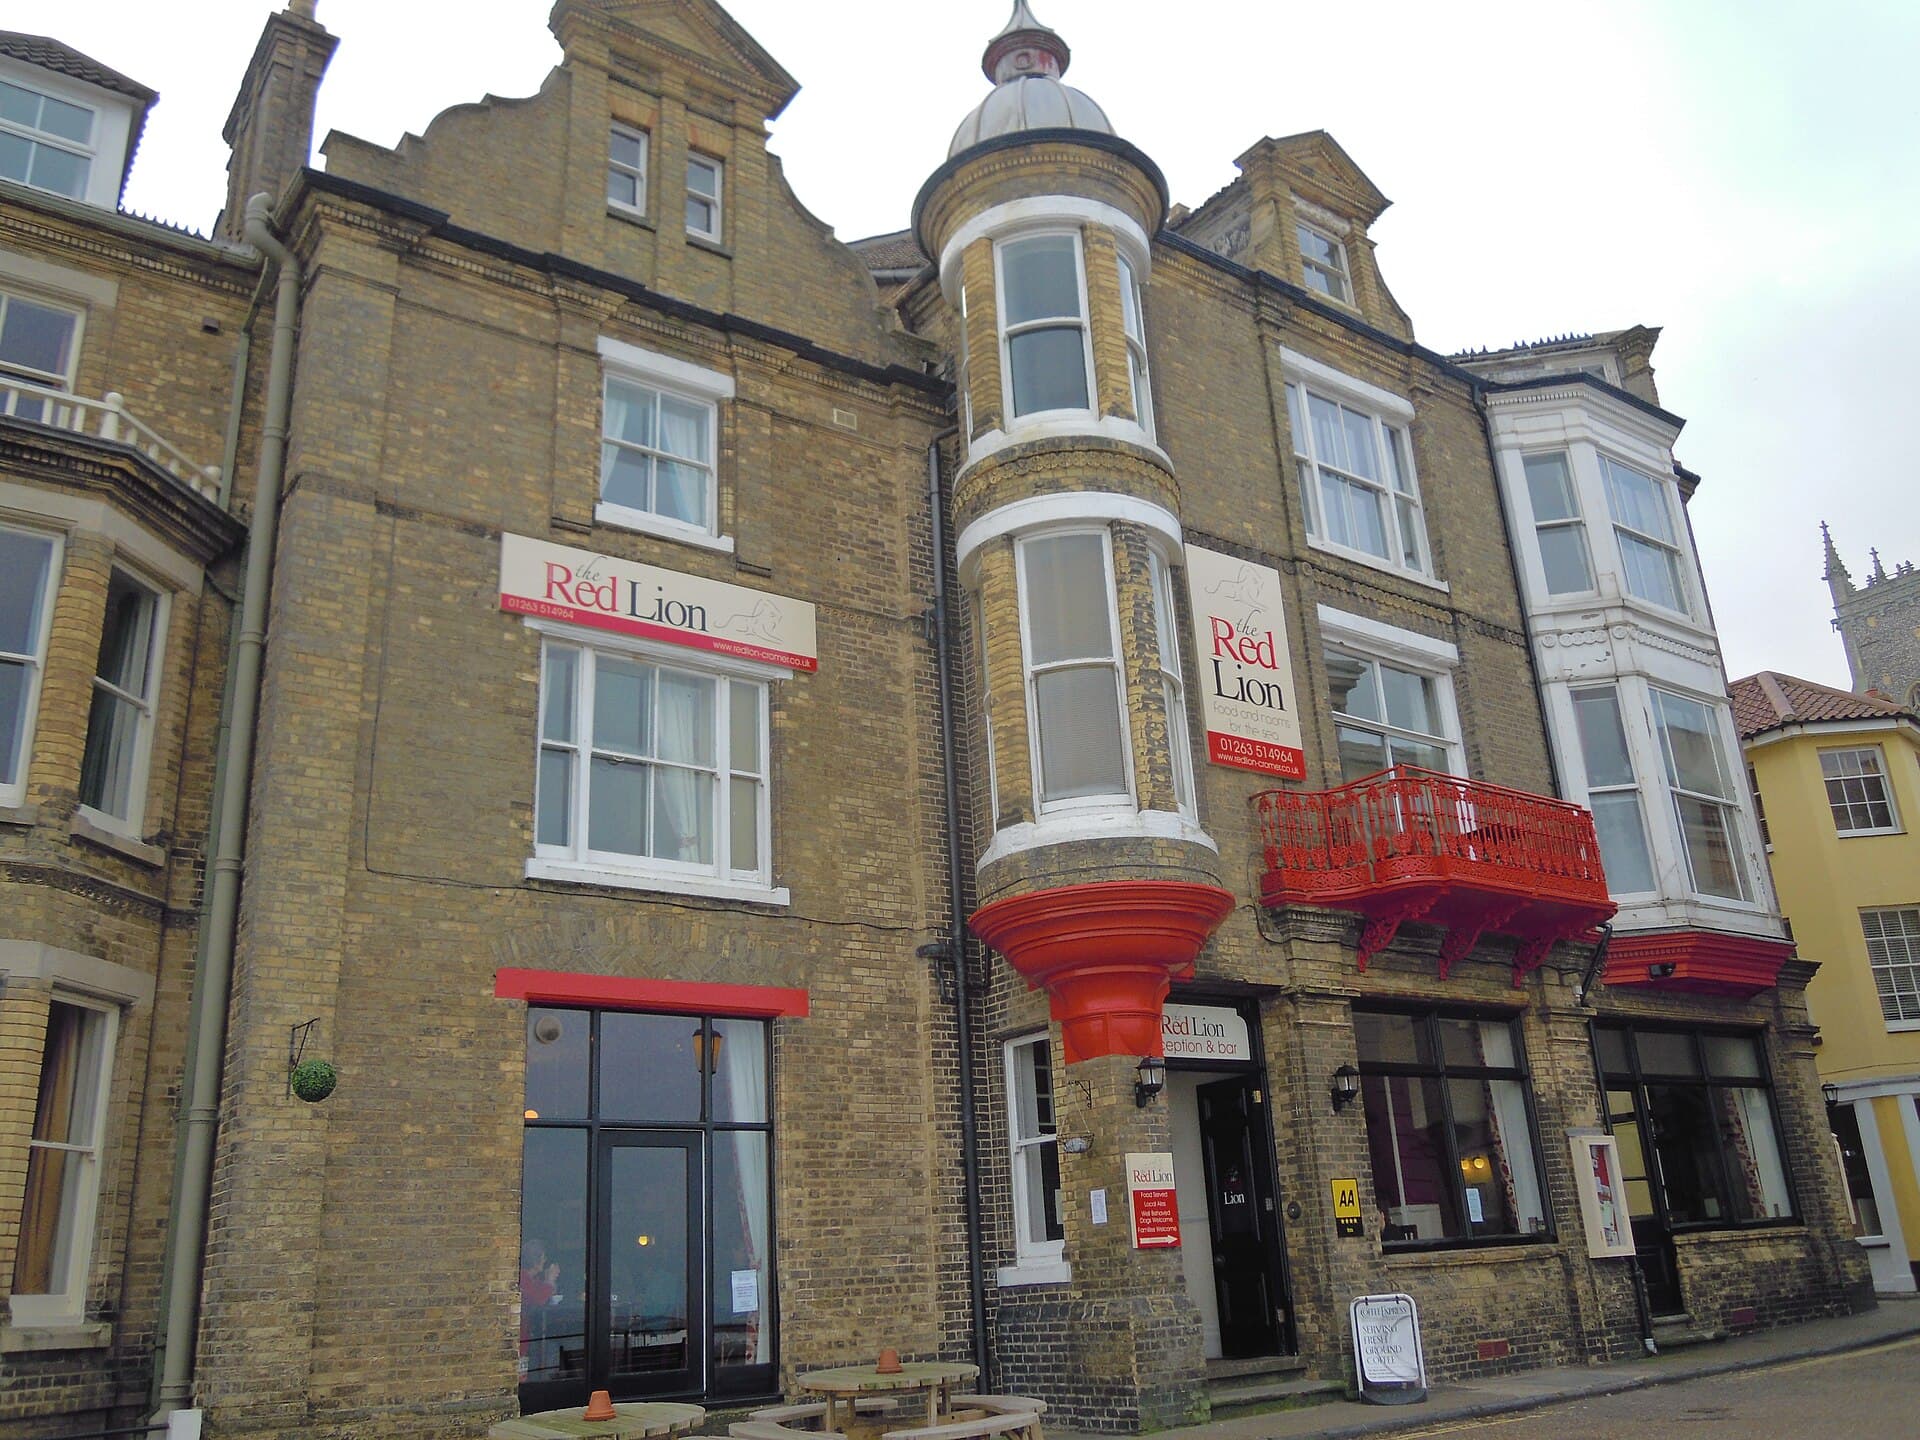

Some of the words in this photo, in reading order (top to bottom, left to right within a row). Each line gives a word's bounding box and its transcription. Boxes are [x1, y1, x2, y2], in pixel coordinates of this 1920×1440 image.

[575, 555, 607, 582] the
[508, 597, 538, 612] 01263
[539, 602, 574, 621] 514964
[544, 561, 618, 612] Red
[627, 579, 708, 632] Lion
[1236, 609, 1262, 637] the
[712, 641, 811, 668] www.redlion-cromer.co.uk
[1208, 615, 1280, 670] Red
[1209, 658, 1288, 711] Lion
[1213, 701, 1239, 717] food
[1240, 710, 1259, 722] and
[1260, 714, 1291, 729] rooms
[1229, 719, 1241, 733] by
[1245, 723, 1260, 736] the
[1262, 728, 1280, 741] sea
[1220, 737, 1253, 756] 01263
[1255, 745, 1293, 763] 514964
[1217, 752, 1300, 775] www.redlion-cromer.co.uk
[1162, 1015, 1189, 1035] Red
[1192, 1017, 1225, 1037] Lion
[1206, 1040, 1215, 1053] &
[1218, 1041, 1237, 1054] bar
[1133, 1169, 1151, 1182] Red
[1152, 1169, 1173, 1182] Lion
[1224, 1191, 1245, 1205] Lion
[1340, 1189, 1355, 1207] AA
